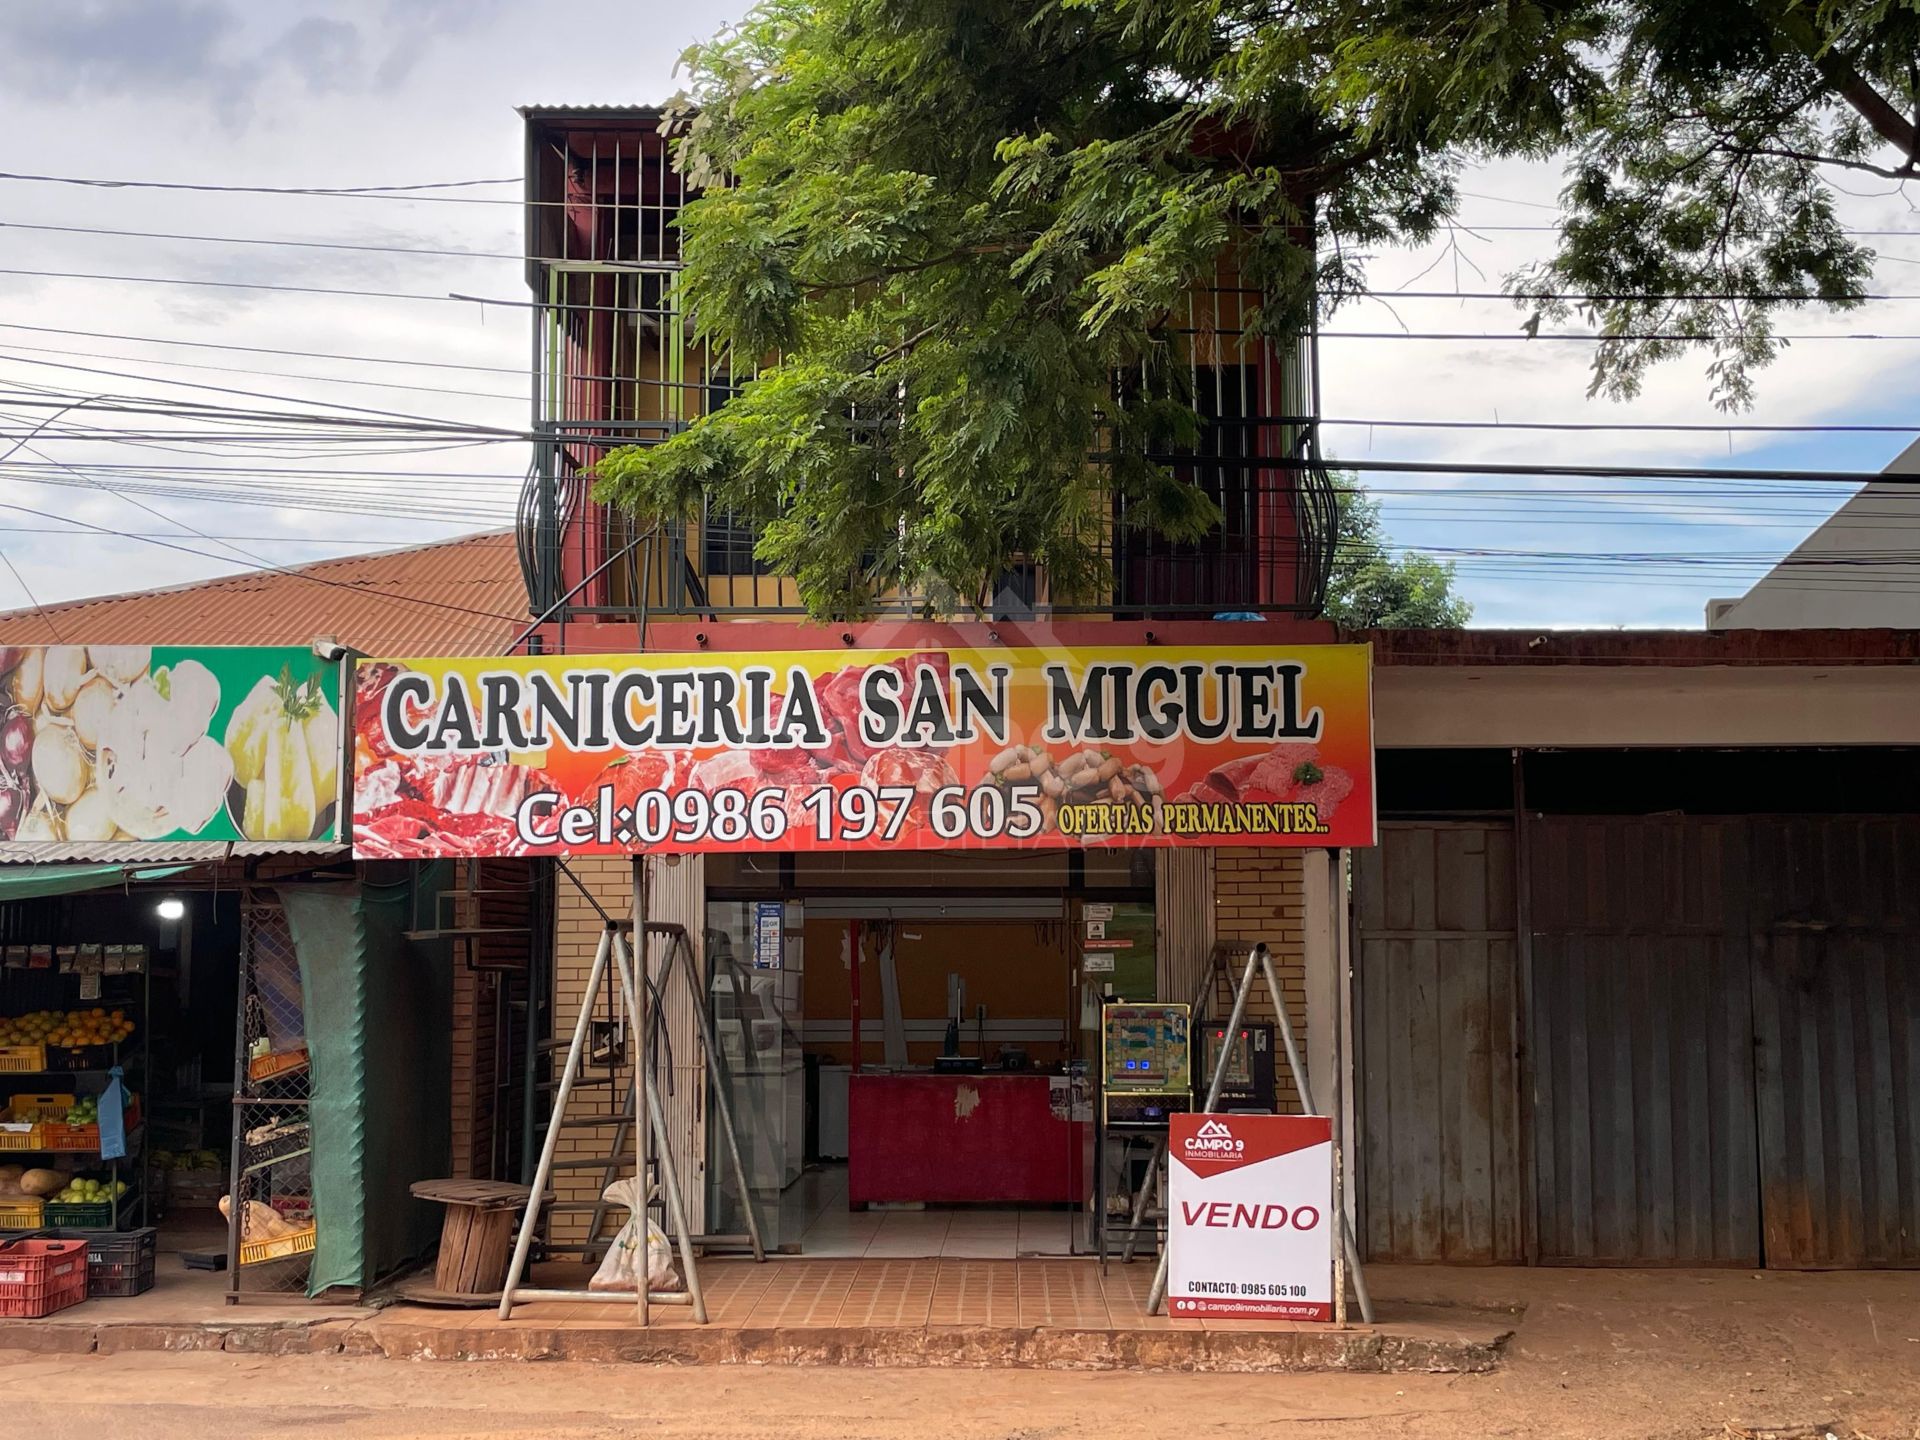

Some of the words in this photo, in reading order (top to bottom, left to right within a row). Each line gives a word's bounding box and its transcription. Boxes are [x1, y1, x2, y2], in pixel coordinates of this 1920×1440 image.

[383, 667, 830, 751] CARNICERIA
[860, 661, 1011, 747] SAN
[1042, 660, 1325, 744] MIGUEL
[802, 785, 916, 842] 197
[929, 783, 1043, 839] 605
[1057, 802, 1154, 835] OFERTAS
[1185, 1138, 1233, 1151] CAMPO
[1235, 1140, 1244, 1152] 9
[1185, 1150, 1243, 1158] INMOBILIARIA
[1181, 1201, 1320, 1231] VENDO
[1188, 1281, 1239, 1294] CONTACTO:
[1241, 1283, 1266, 1296] 0985
[1268, 1284, 1288, 1297] 605
[1289, 1285, 1307, 1297] 100
[1207, 1303, 1320, 1316] campo9inmobiliaria.com.py
